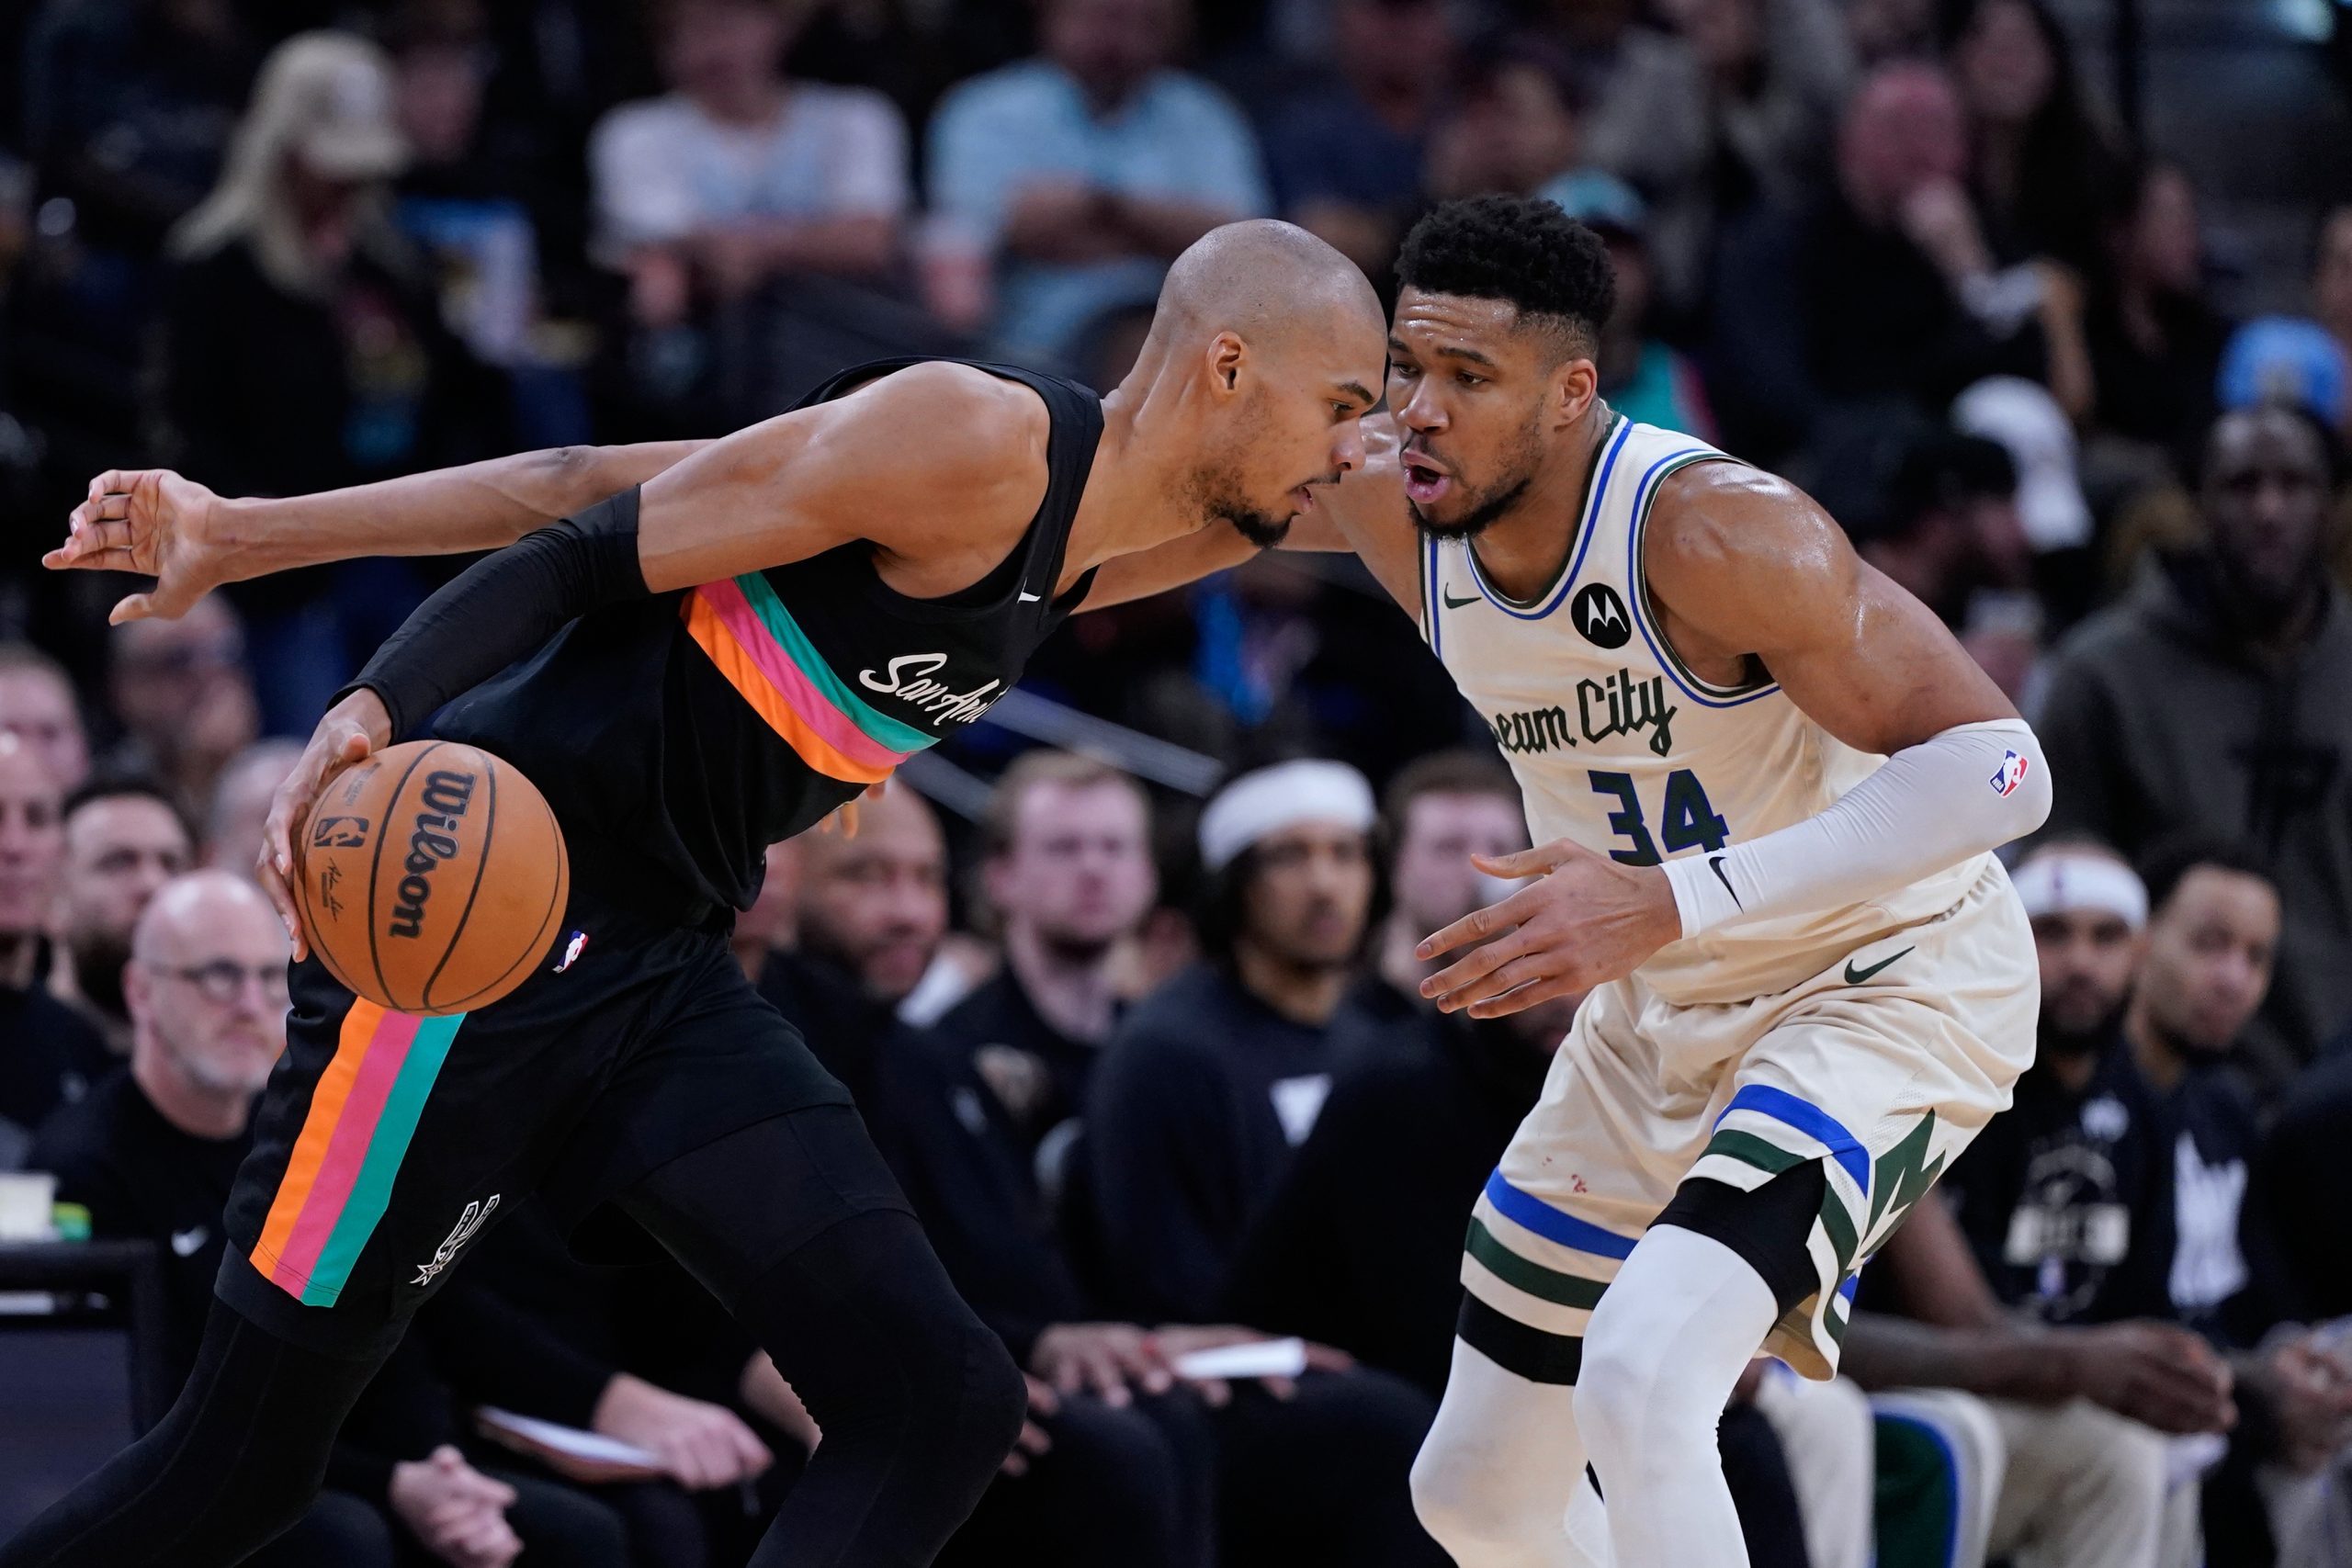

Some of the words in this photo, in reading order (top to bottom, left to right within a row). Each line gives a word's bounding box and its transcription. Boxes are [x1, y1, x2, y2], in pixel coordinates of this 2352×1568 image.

[859, 652, 949, 705] San
[1576, 667, 1678, 758] City
[388, 770, 477, 940] Wilson
[1588, 768, 1730, 867] 34
